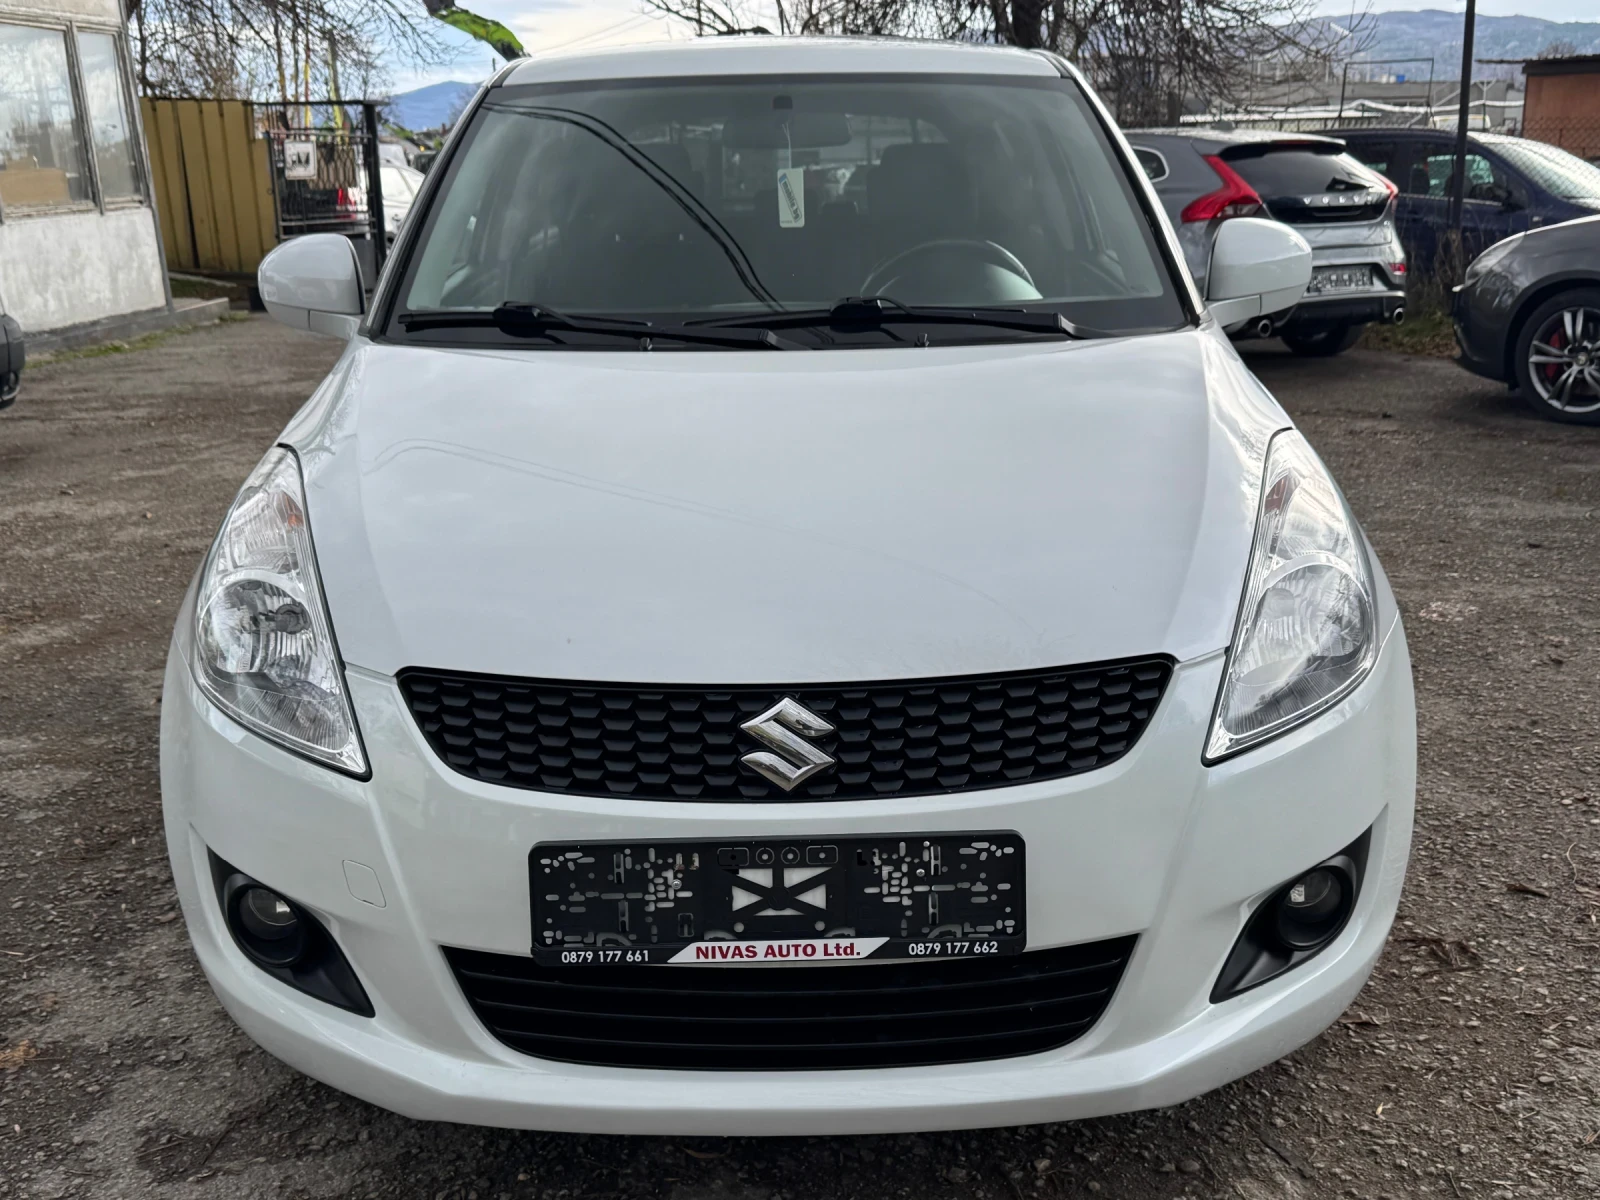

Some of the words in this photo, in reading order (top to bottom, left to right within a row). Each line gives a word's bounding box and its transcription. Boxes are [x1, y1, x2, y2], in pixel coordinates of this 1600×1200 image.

[695, 945, 758, 960] NIVAS
[763, 943, 817, 959] AUTO
[823, 942, 861, 957] Ltd.
[908, 943, 941, 955] 0879
[945, 942, 970, 954] 177
[973, 941, 998, 954] 662
[561, 951, 594, 963] 0879
[598, 950, 622, 963] 177
[625, 949, 649, 962] 661
